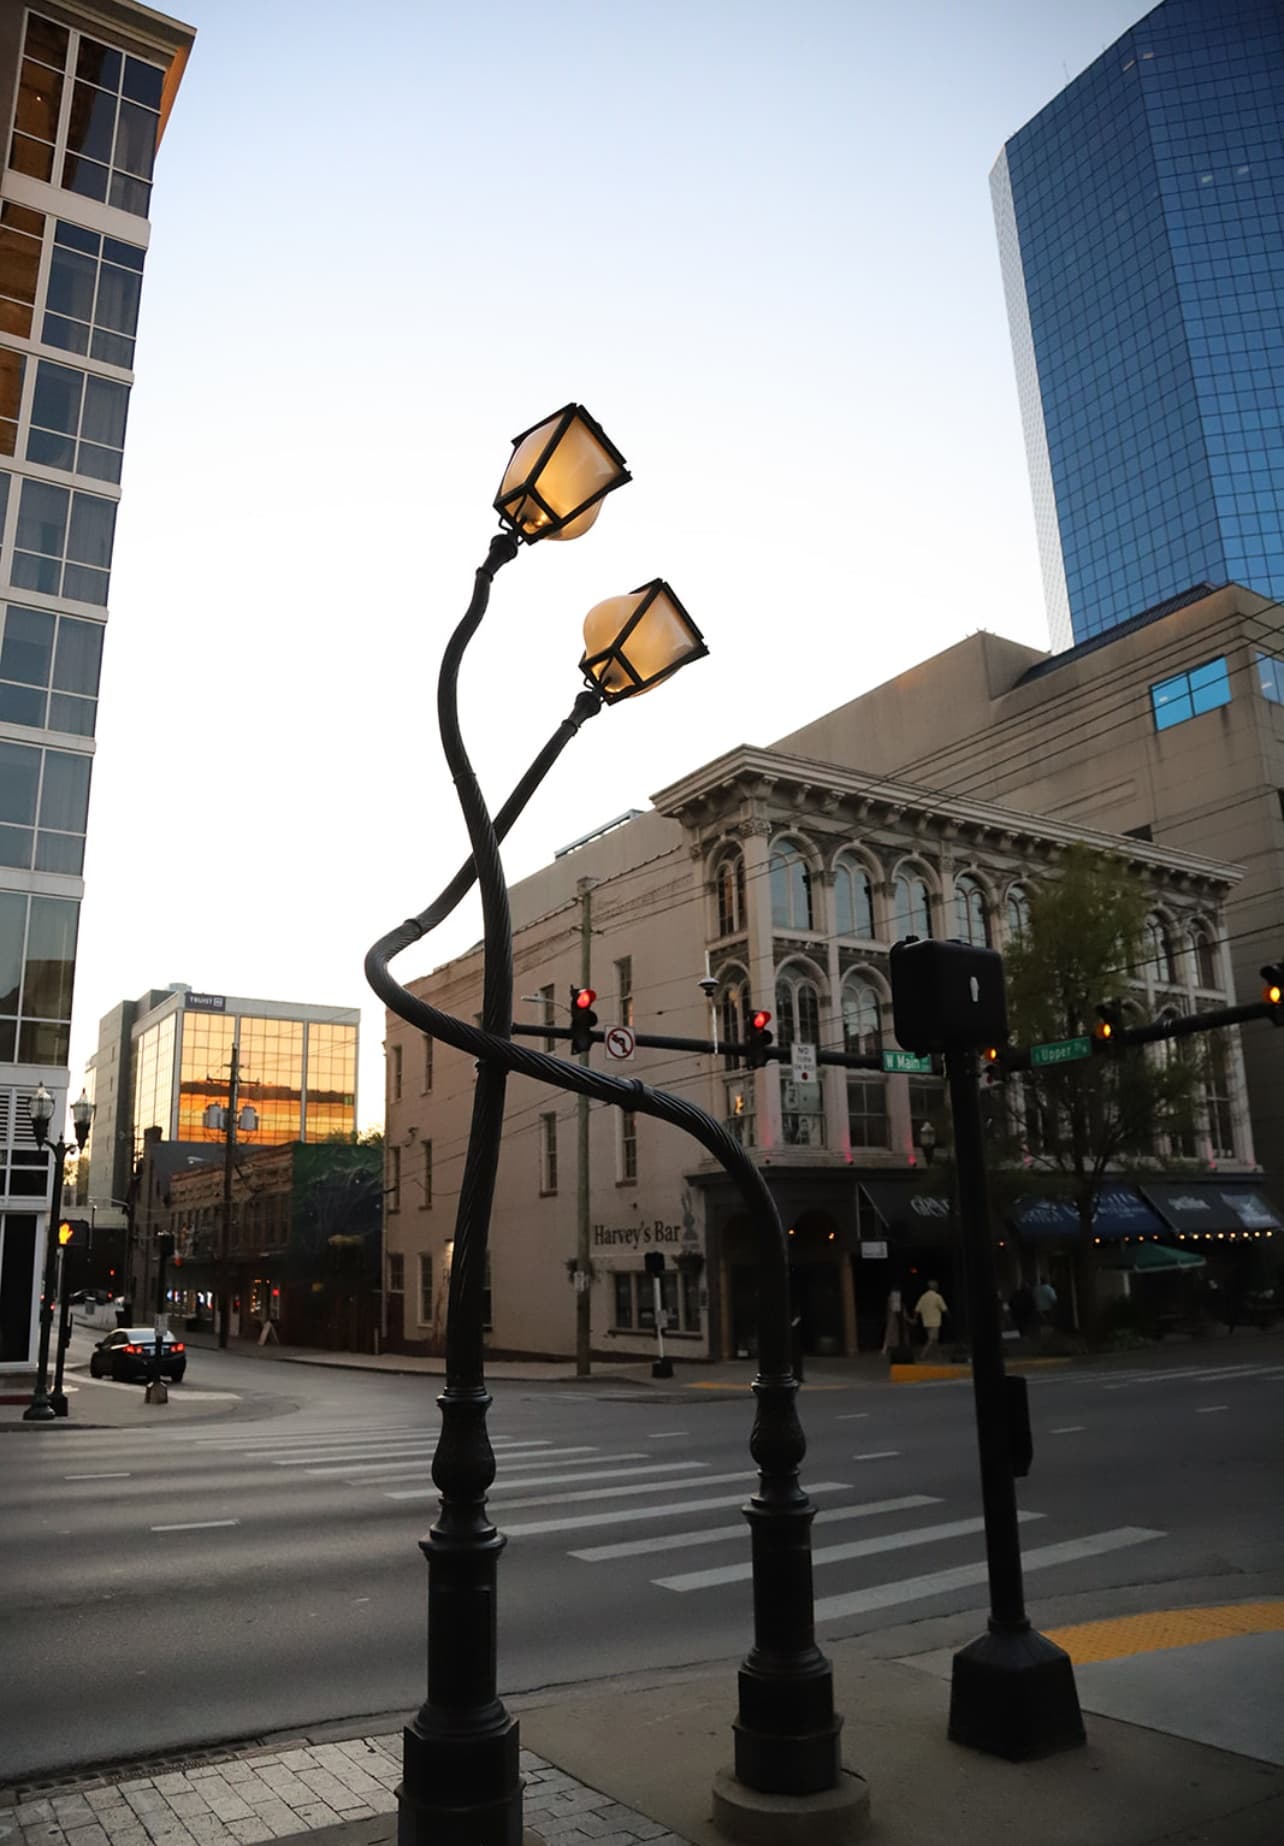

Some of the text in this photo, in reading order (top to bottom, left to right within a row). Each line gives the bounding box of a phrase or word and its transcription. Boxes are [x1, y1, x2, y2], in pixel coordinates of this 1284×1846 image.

[897, 1055, 920, 1069] Main
[1041, 1047, 1071, 1062] Upper
[594, 1220, 681, 1250] Harvey's Bar
